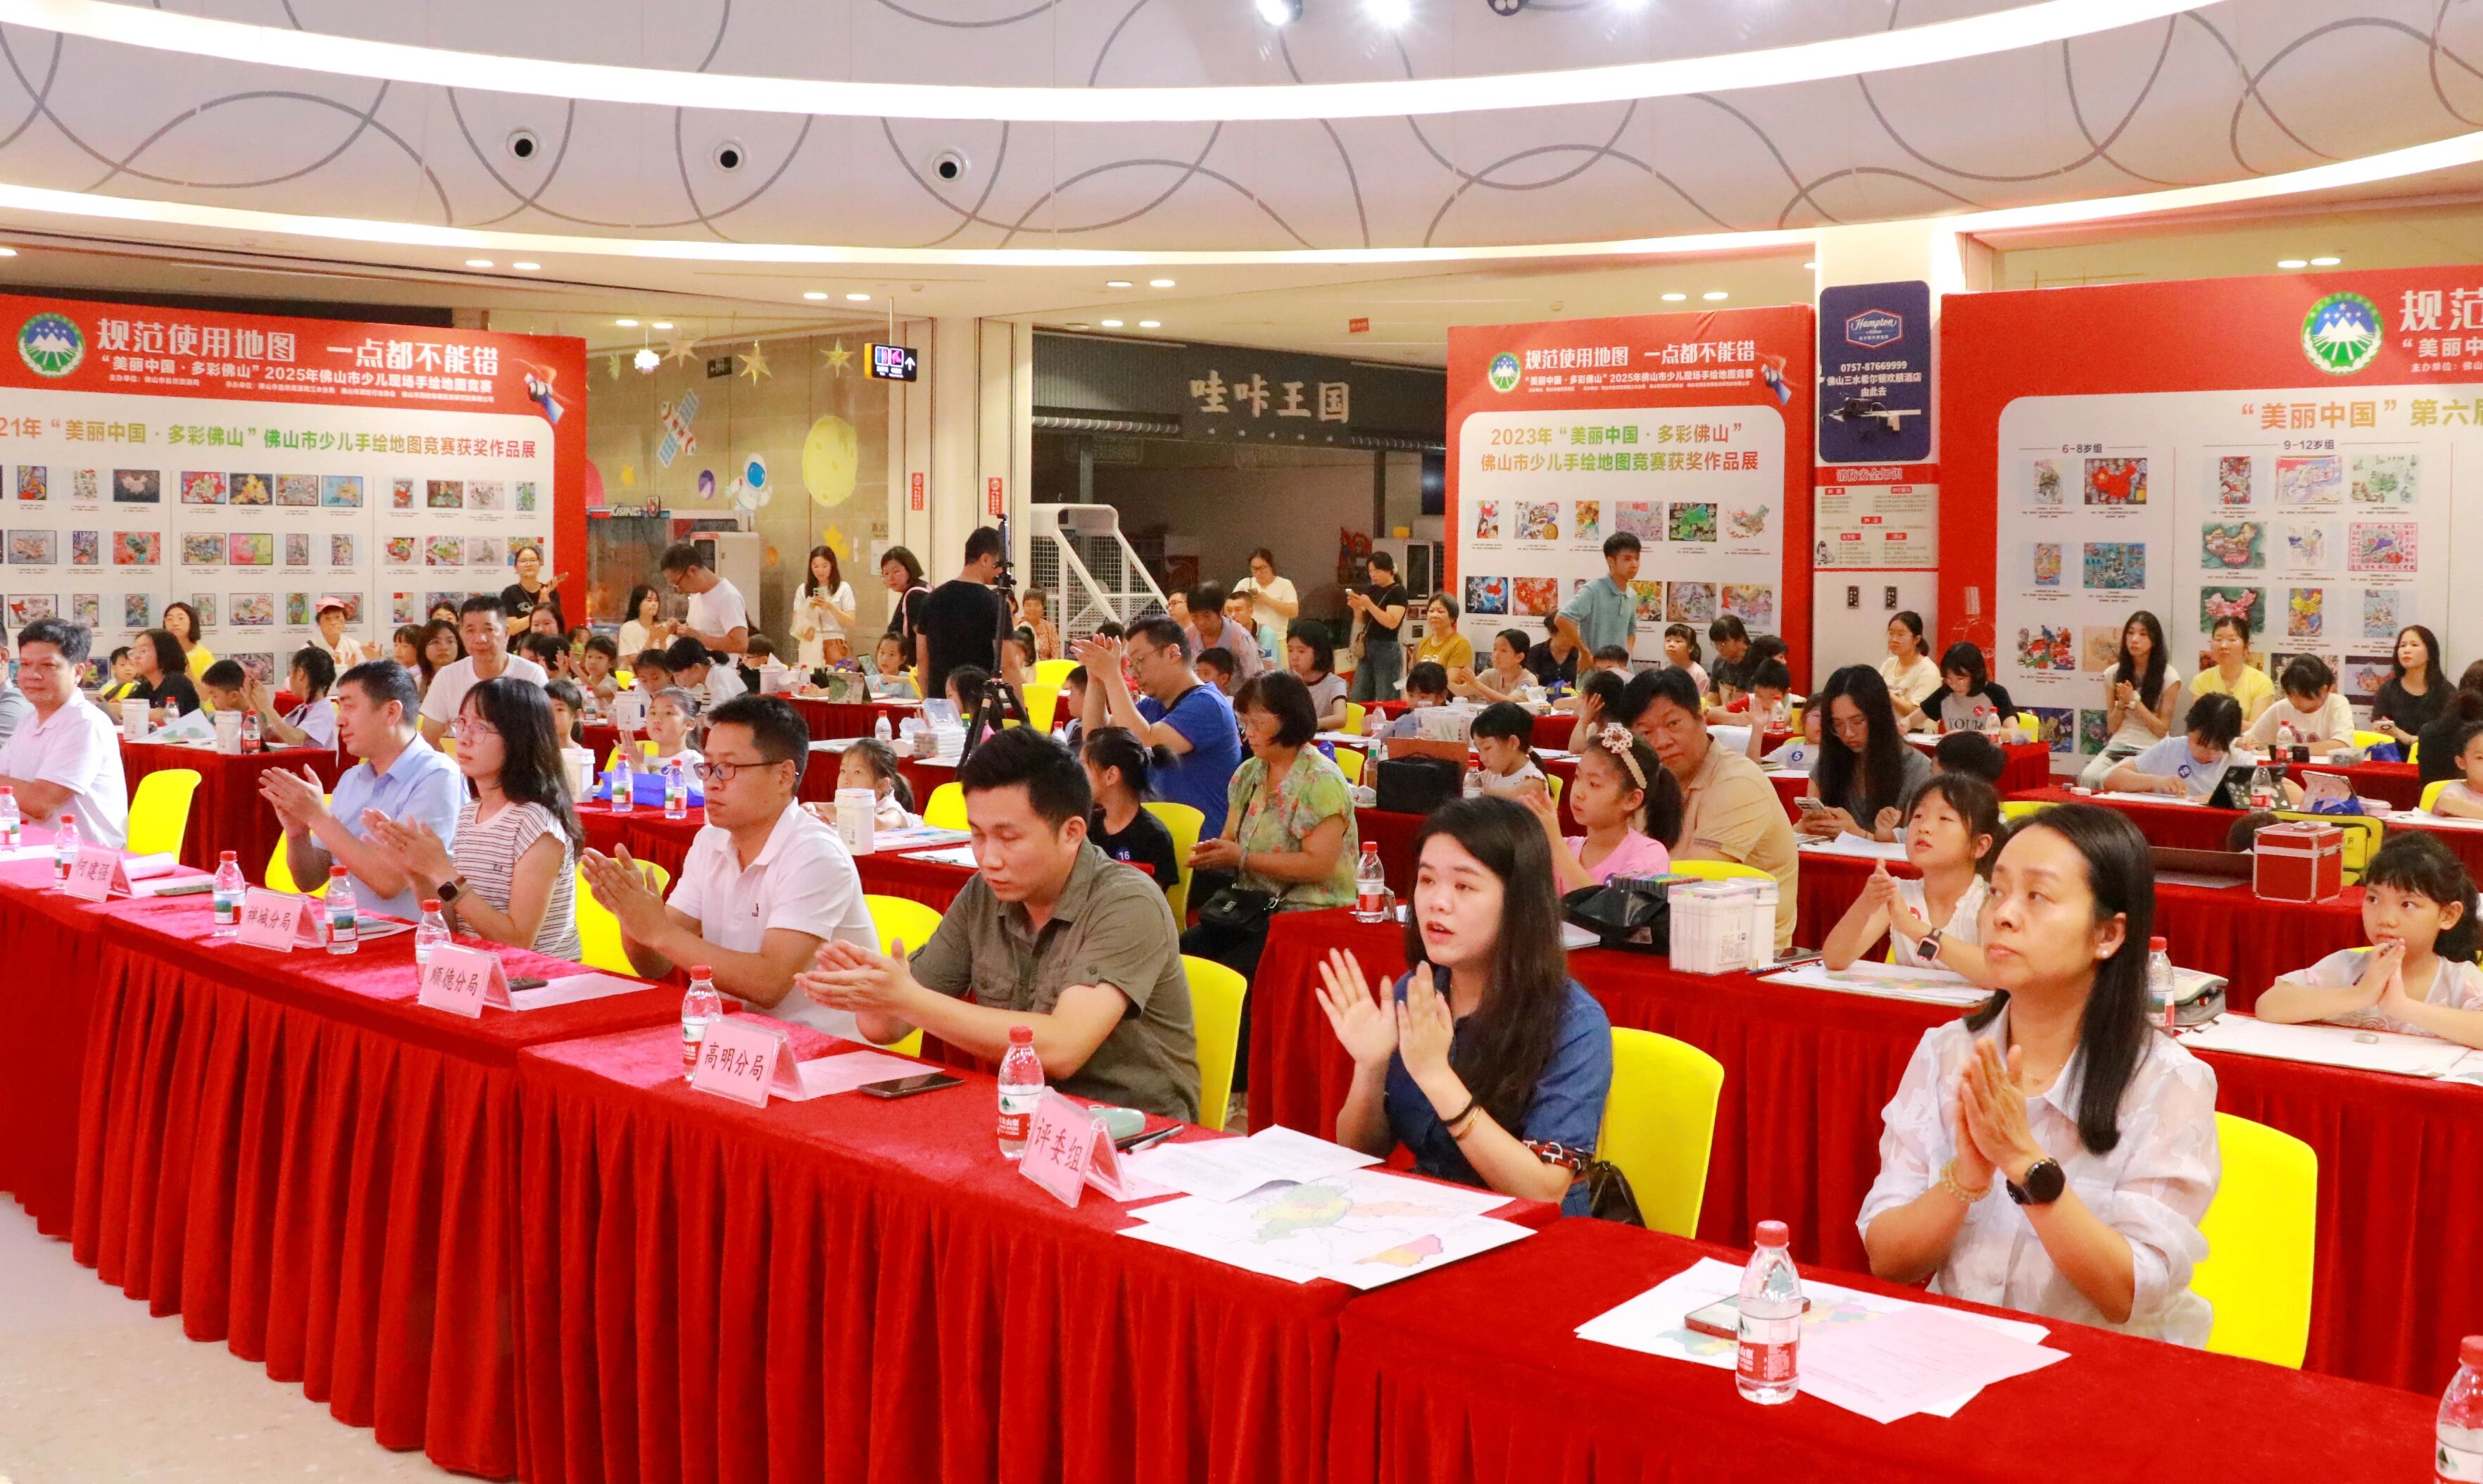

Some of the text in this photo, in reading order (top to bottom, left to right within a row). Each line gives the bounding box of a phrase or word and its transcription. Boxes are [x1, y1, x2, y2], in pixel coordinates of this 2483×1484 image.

[1851, 318, 1897, 330] Hampton
[97, 318, 499, 376] 规范使用地图 一点都不能错
[1525, 340, 1755, 370] 规范使用地图 一点都不能错
[1840, 360, 1908, 372] 0757-87669999
[1827, 372, 1922, 386] 佛山三水希尔顿欢朋酒店
[1190, 369, 1350, 424] 哇咔王国
[1861, 386, 1887, 398] 由此去
[2062, 444, 2103, 453] 6-8岁组
[2284, 439, 2335, 450] 9-12岁组
[1481, 451, 1759, 472] 佛山市少儿手绘地图竞赛获奖作品展
[1836, 467, 1904, 482] 消防安全知识
[1949, 718, 1983, 730] YOUR
[1793, 752, 1802, 760] 5
[1119, 850, 1130, 860] 16
[77, 857, 111, 881] 何建强
[247, 905, 291, 931] 禅城分局
[429, 966, 478, 996] 顺德分局
[704, 1042, 764, 1081] 高明分局
[1034, 1117, 1083, 1173] 评委组
